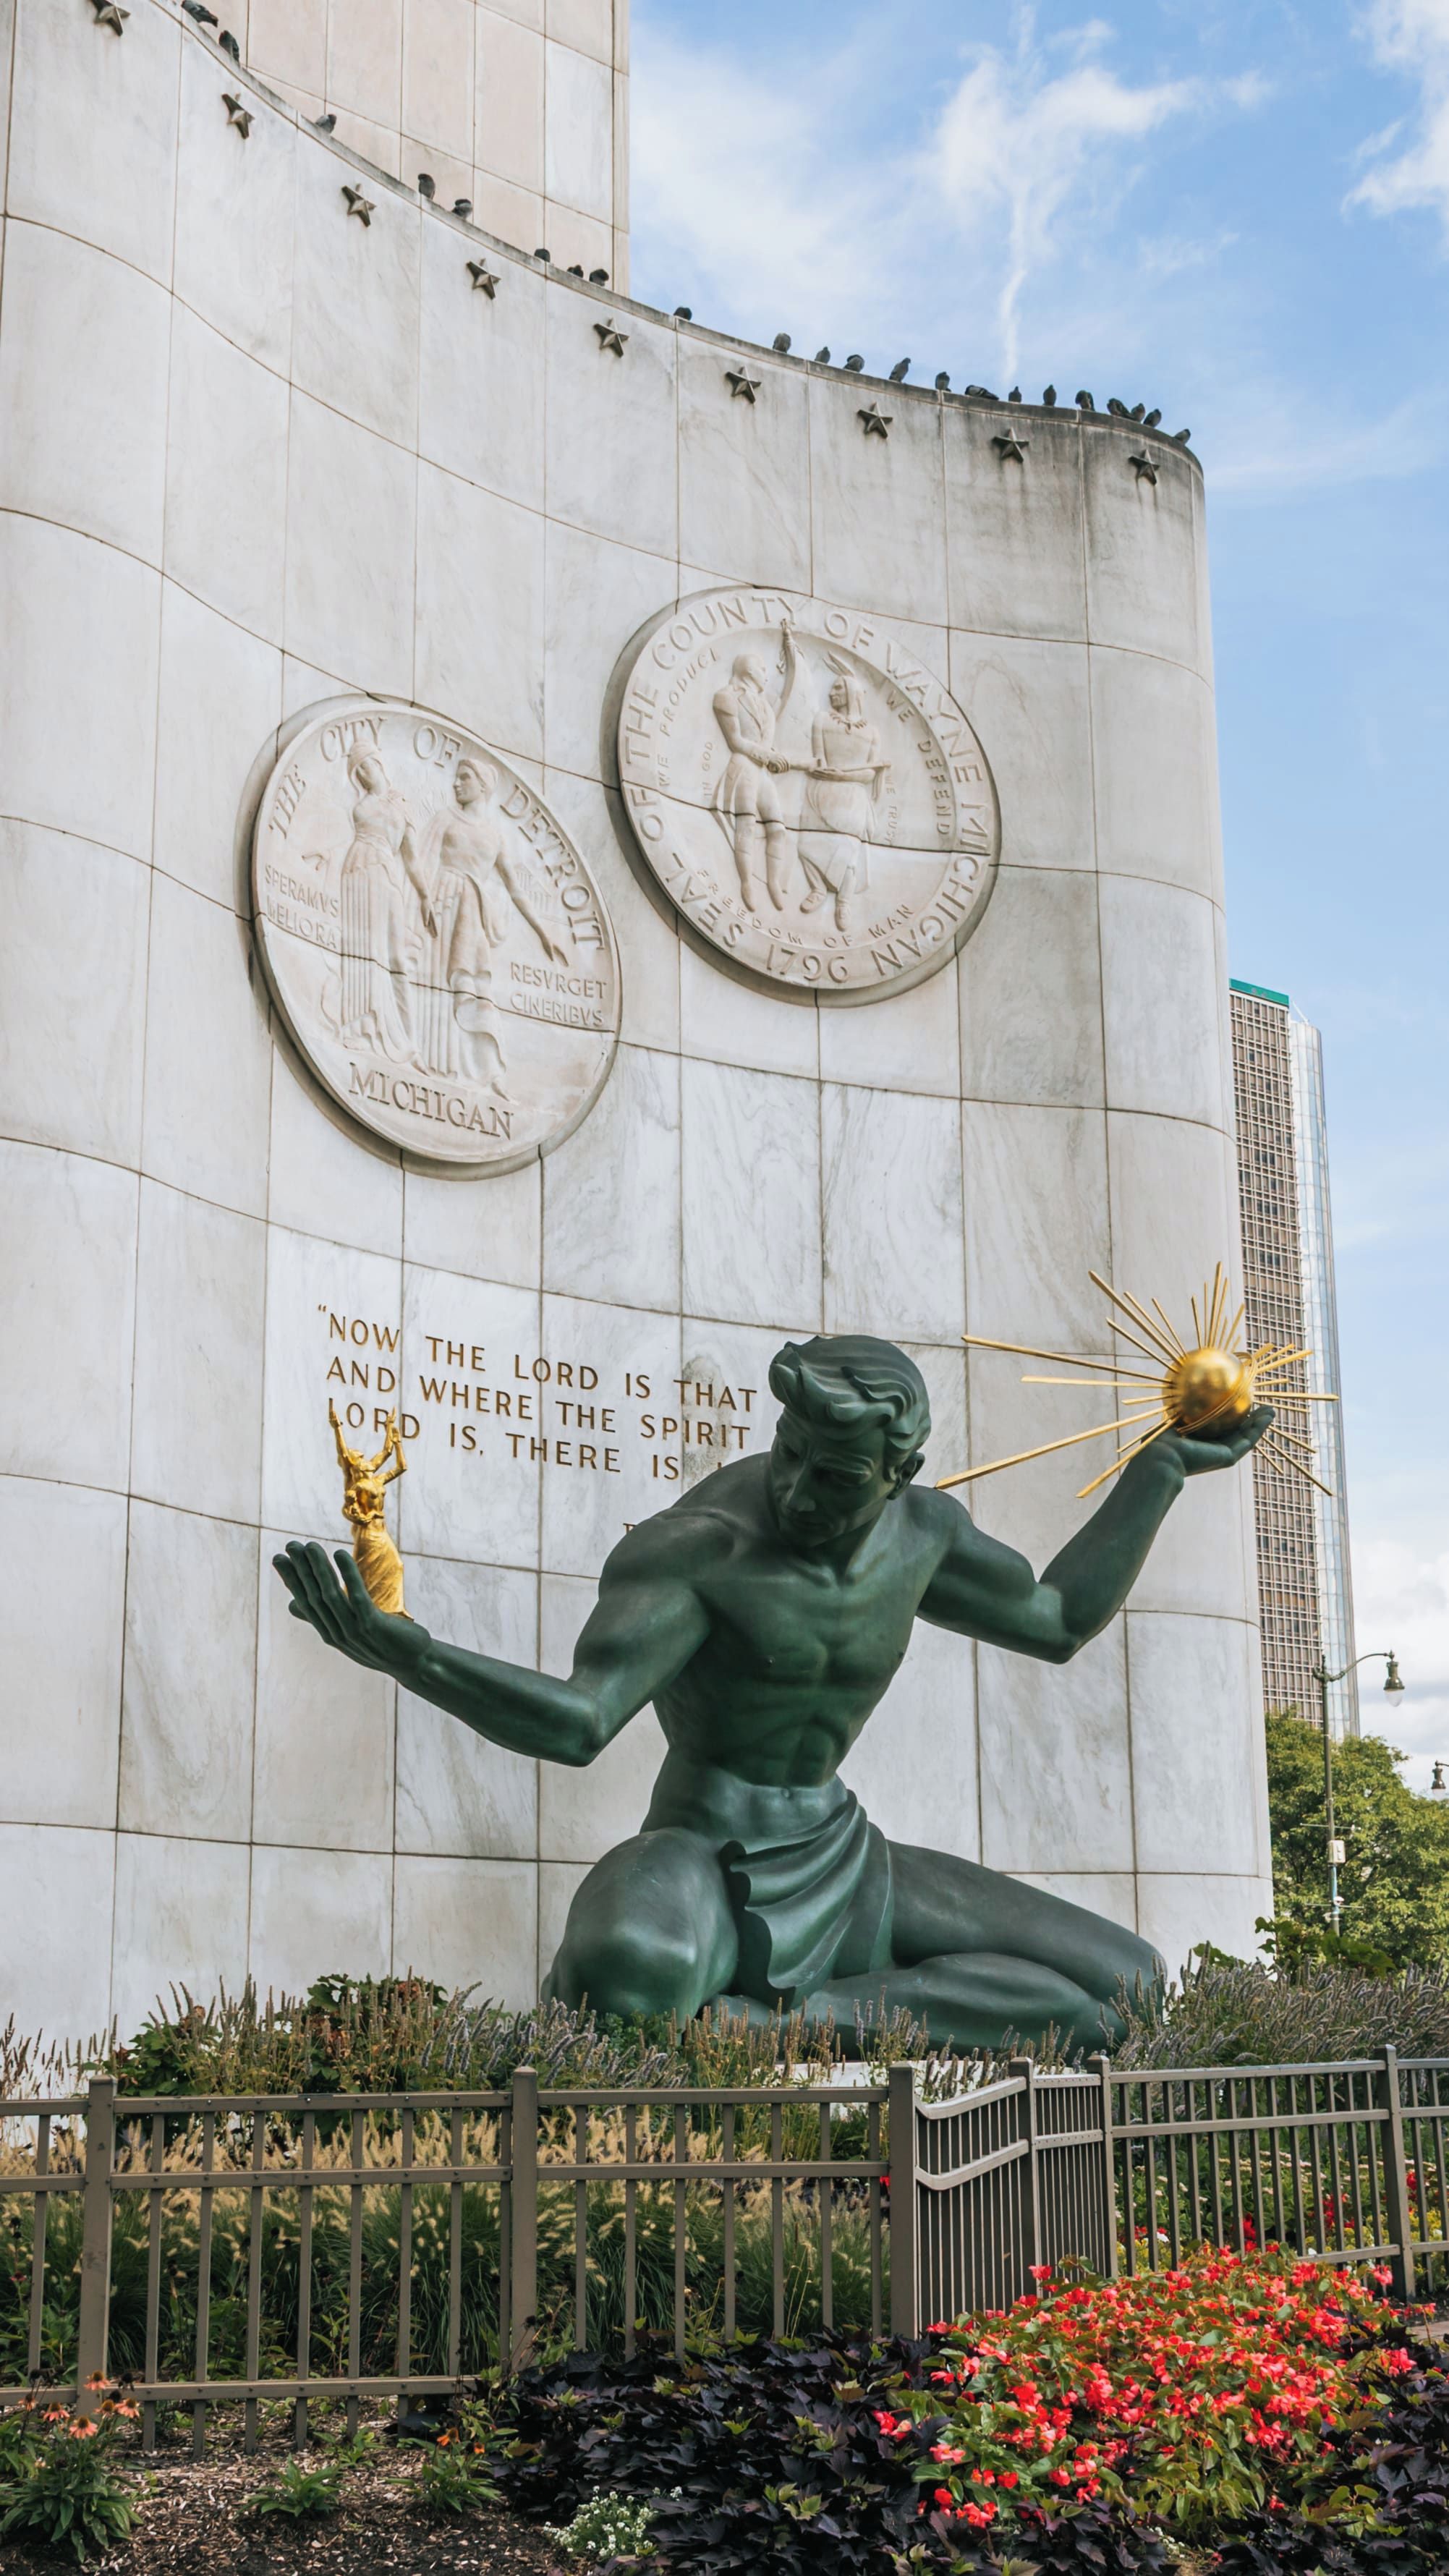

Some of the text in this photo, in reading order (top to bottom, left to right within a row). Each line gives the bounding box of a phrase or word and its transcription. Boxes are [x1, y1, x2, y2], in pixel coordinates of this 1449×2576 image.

[657, 754, 671, 787] WE
[701, 741, 714, 772] GOD
[886, 689, 952, 836] WE DEFEND
[624, 596, 989, 976] SEAL OF THE COUNTY OF WAYNE MICHIGAN
[268, 717, 605, 951] THE CITY OF DETROIT
[883, 804, 898, 845] TRUST
[264, 863, 339, 919] SPERAMVS
[696, 869, 916, 948] FREEDOM OF MAN
[265, 894, 337, 950] MELIORA
[509, 961, 608, 1000] RESVRGET
[765, 943, 851, 984] 1796
[509, 992, 604, 1027] CINERIBVS
[348, 1061, 514, 1142] MICHIGAN
[326, 1355, 751, 1450] AND WHERE THE SPIRIT
[425, 1335, 486, 1372] THE
[514, 1353, 599, 1391] LORD
[625, 1372, 651, 1399] IS
[673, 1379, 758, 1413] THAT
[450, 1422, 484, 1456] IS,
[504, 1432, 621, 1474] THERE
[653, 1454, 679, 1481] IS
